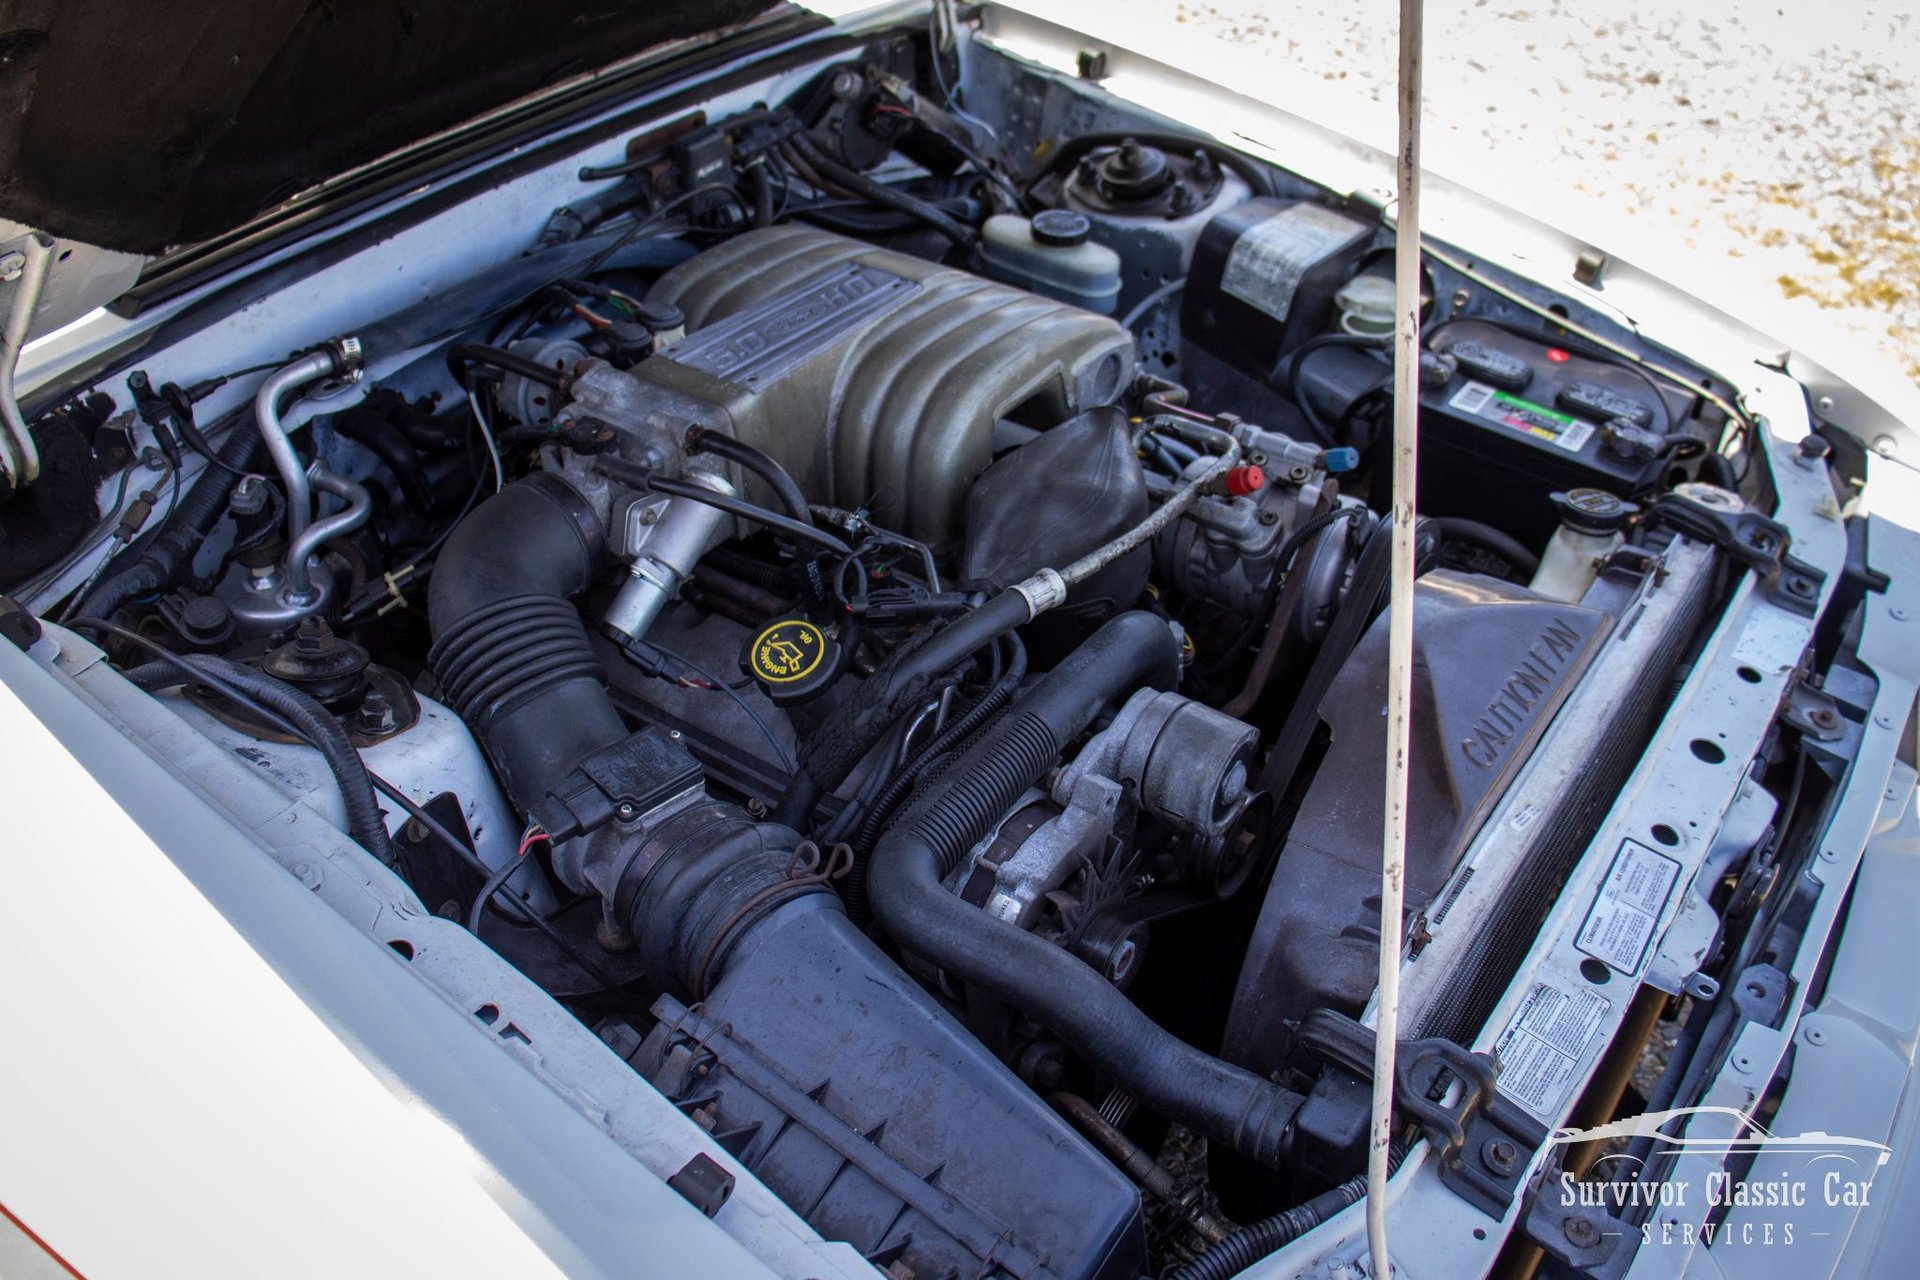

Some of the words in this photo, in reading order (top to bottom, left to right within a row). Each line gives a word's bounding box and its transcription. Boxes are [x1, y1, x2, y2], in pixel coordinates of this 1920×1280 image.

[799, 630, 813, 645] OIL
[760, 646, 787, 675] ENGINE
[1461, 660, 1551, 770] CAUTION
[1528, 617, 1581, 676] FAN
